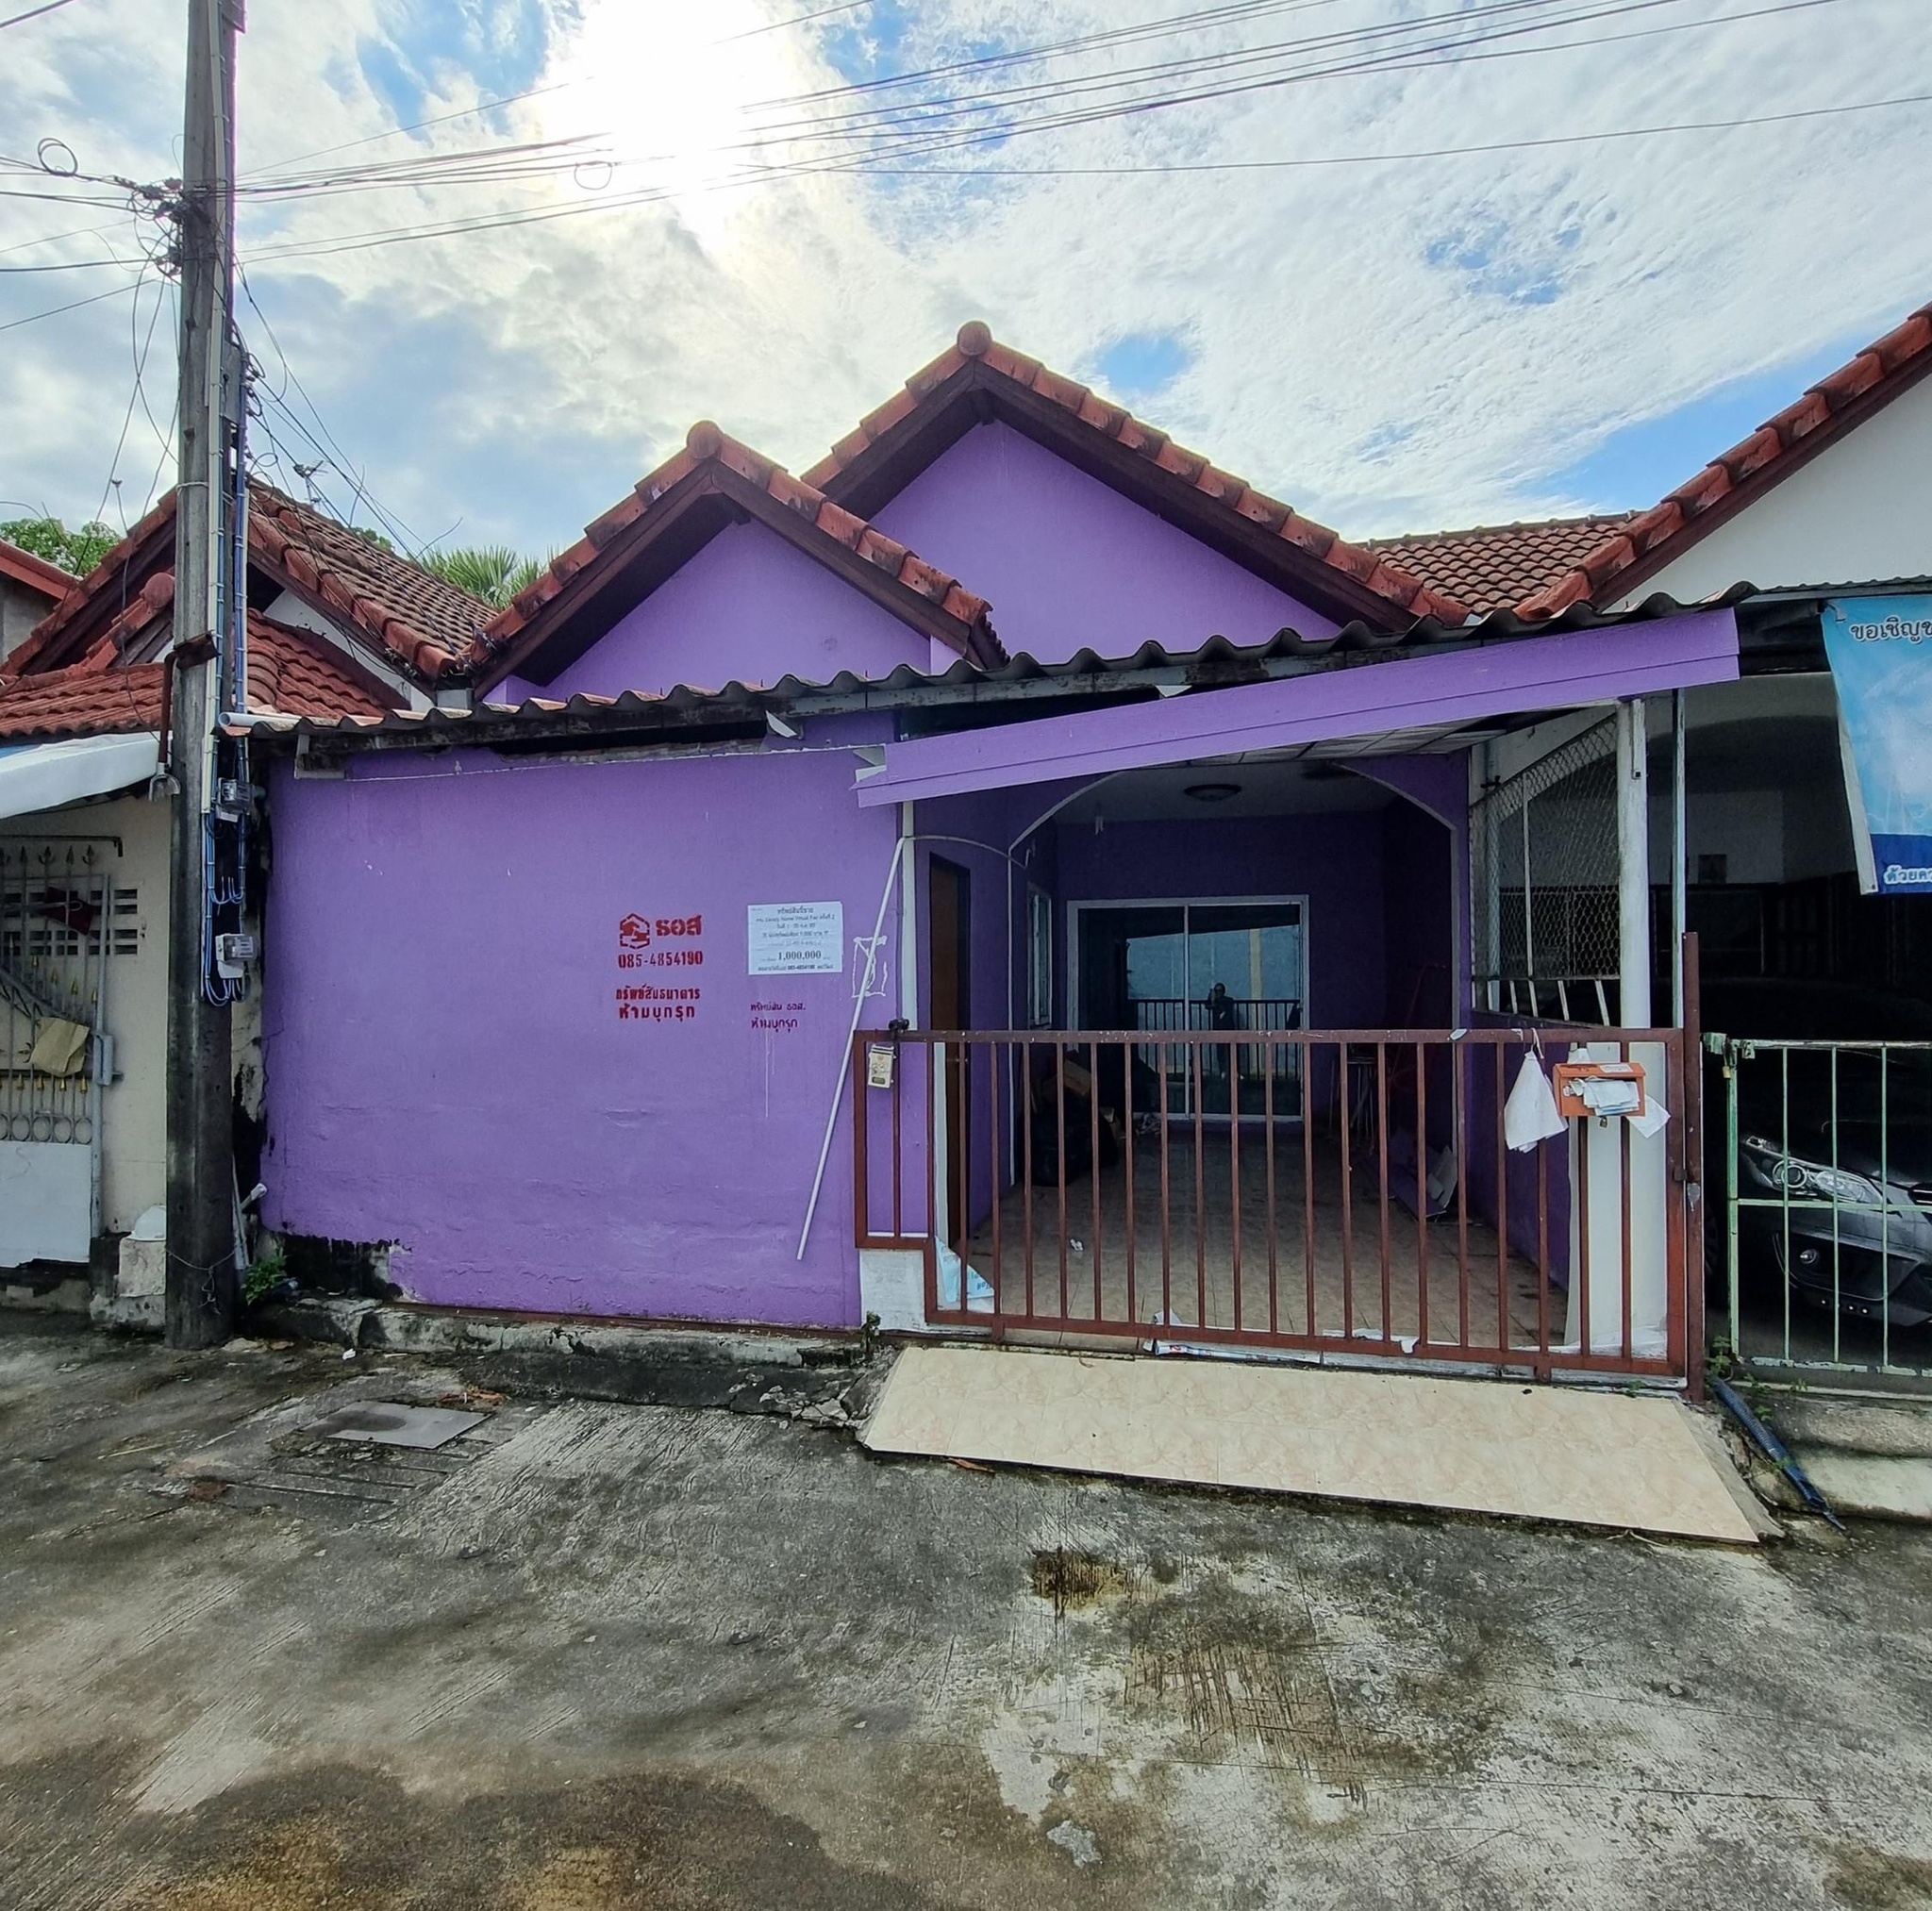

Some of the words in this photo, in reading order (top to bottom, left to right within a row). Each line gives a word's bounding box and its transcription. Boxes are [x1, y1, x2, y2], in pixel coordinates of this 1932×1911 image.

[656, 915, 702, 937] ธอส
[618, 951, 704, 969] 085-4854190
[777, 950, 822, 961] 1,000,000
[616, 983, 700, 1000] ทรัพย์สินธนาคาร
[619, 1003, 695, 1022] ห้ามบุกรุก
[751, 1017, 798, 1033] ห้ามบุกรุก
